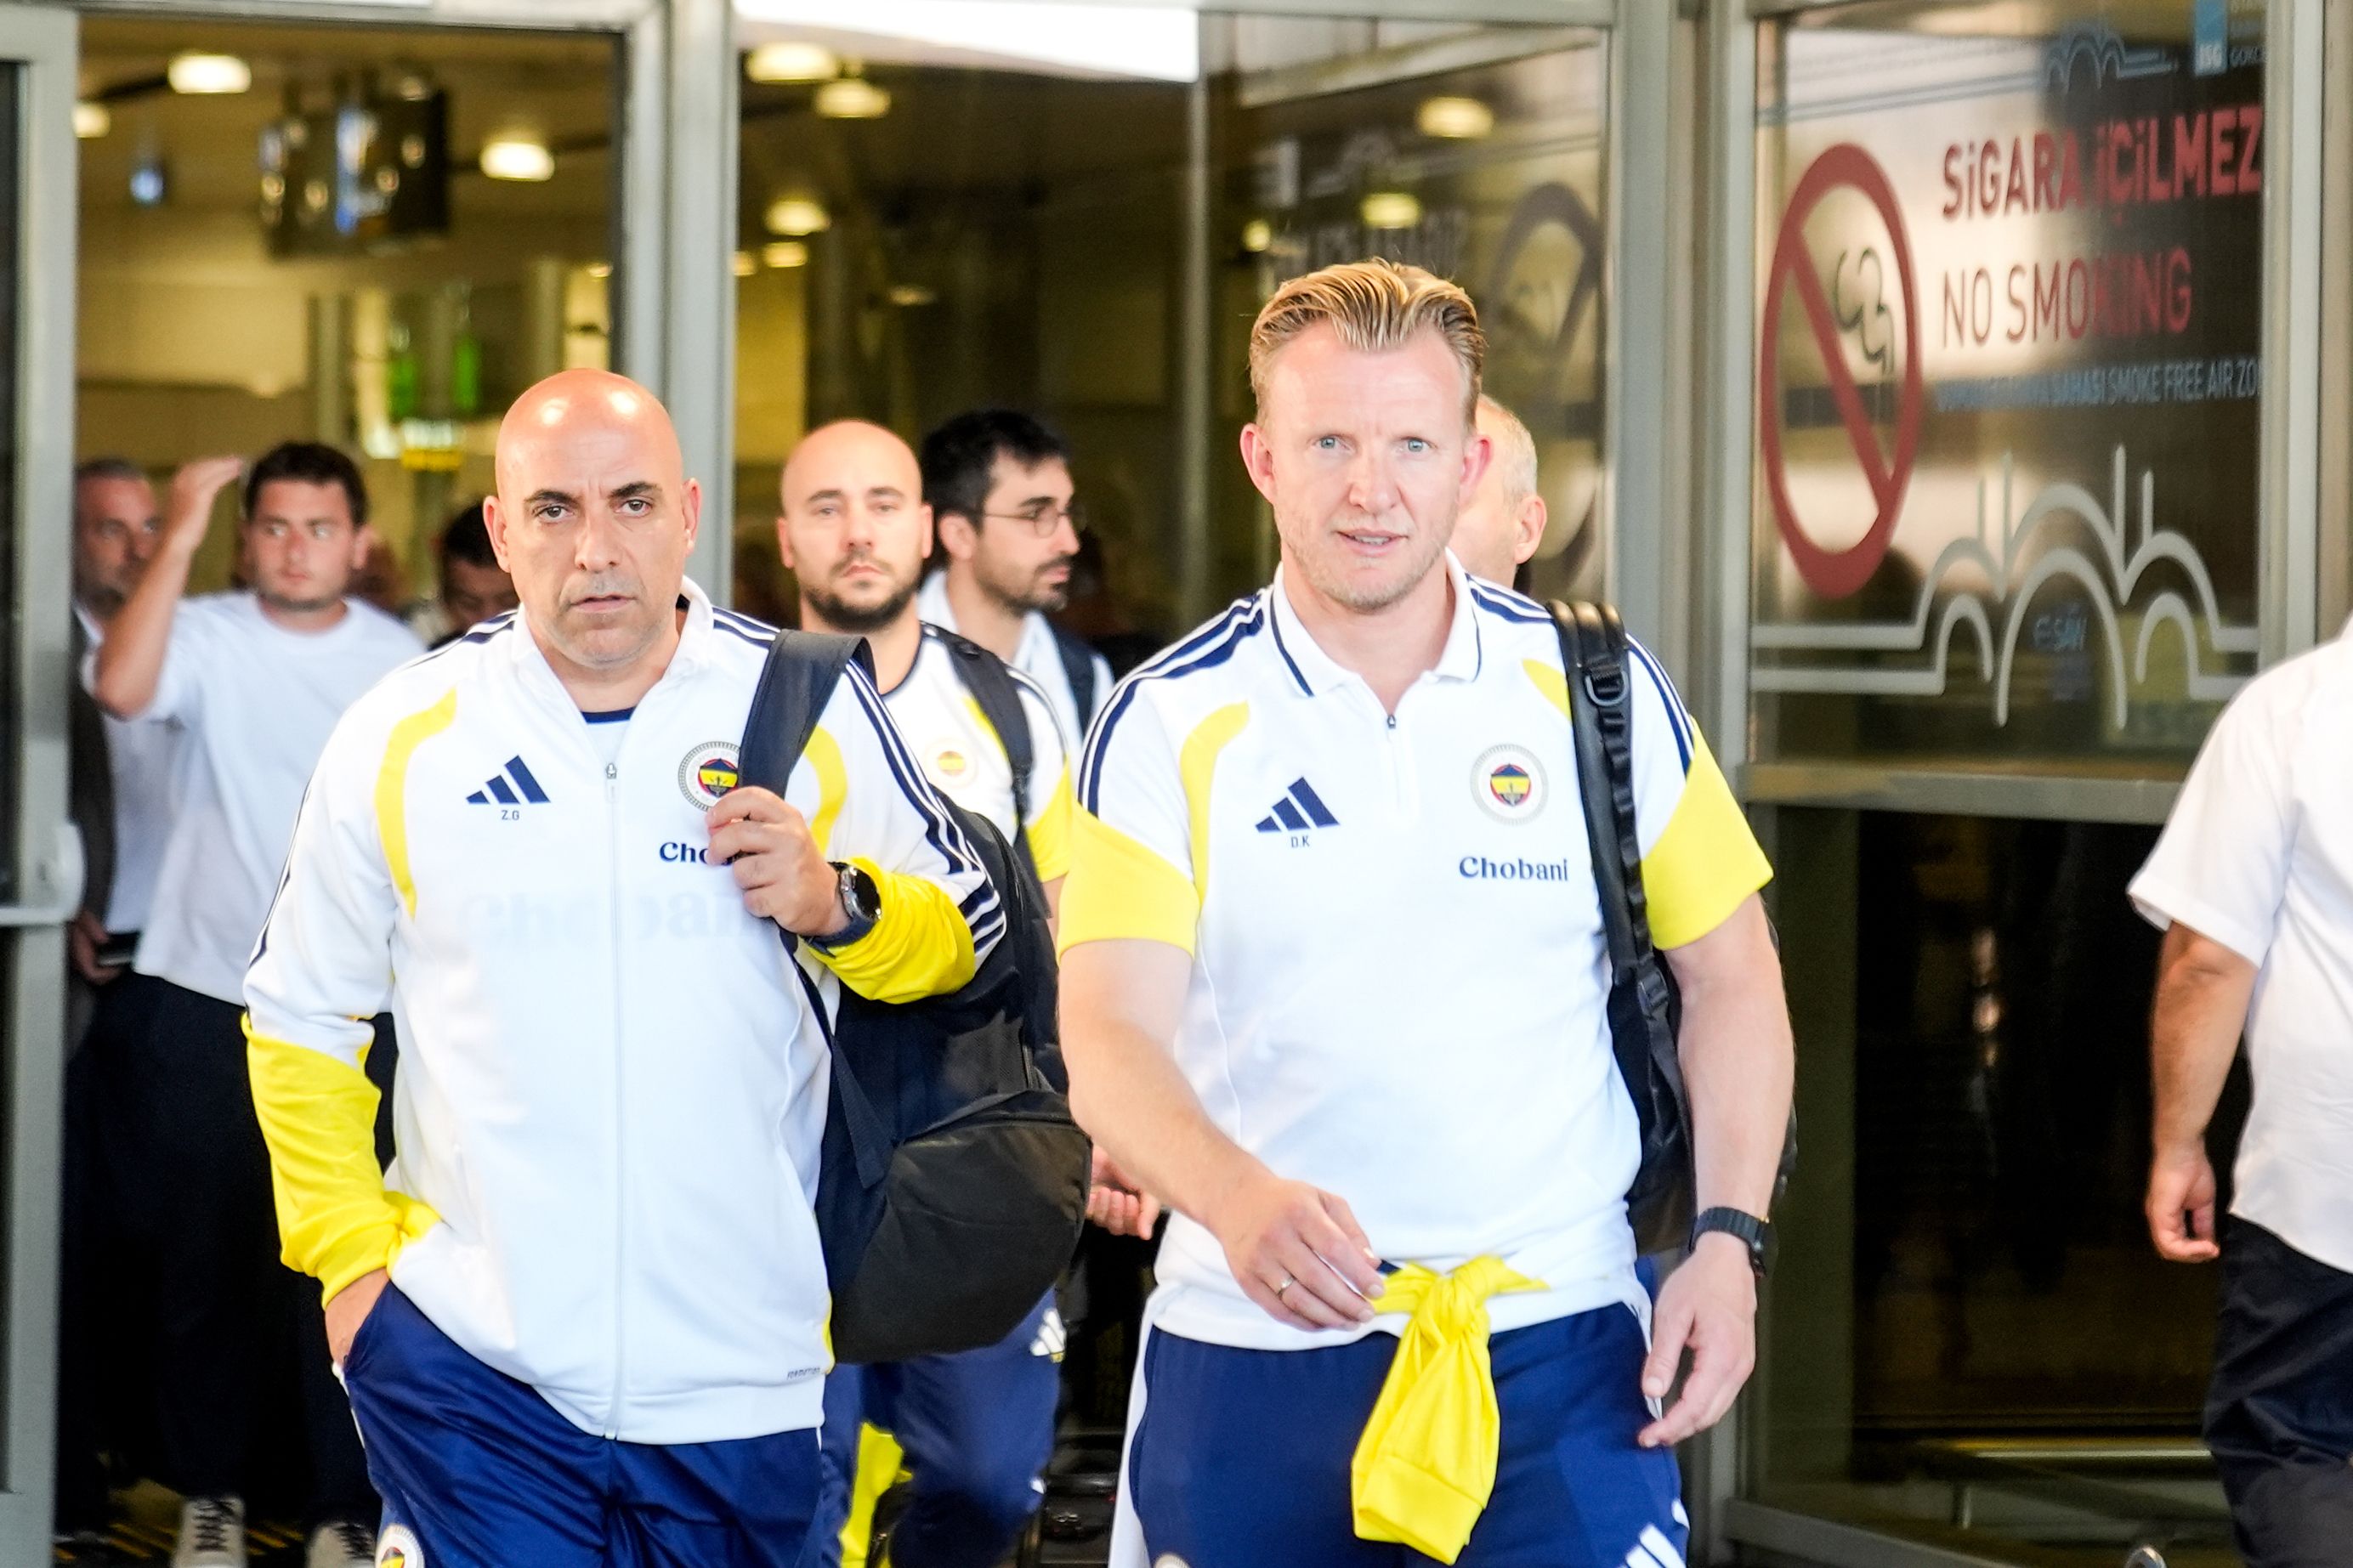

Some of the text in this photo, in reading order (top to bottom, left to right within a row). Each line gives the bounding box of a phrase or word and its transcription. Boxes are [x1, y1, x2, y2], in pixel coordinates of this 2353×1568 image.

[1943, 246, 2192, 350] NO SMOKING
[2163, 360, 2205, 400] FREE
[2207, 359, 2234, 399] AIR
[1459, 856, 1568, 882] Chobani
